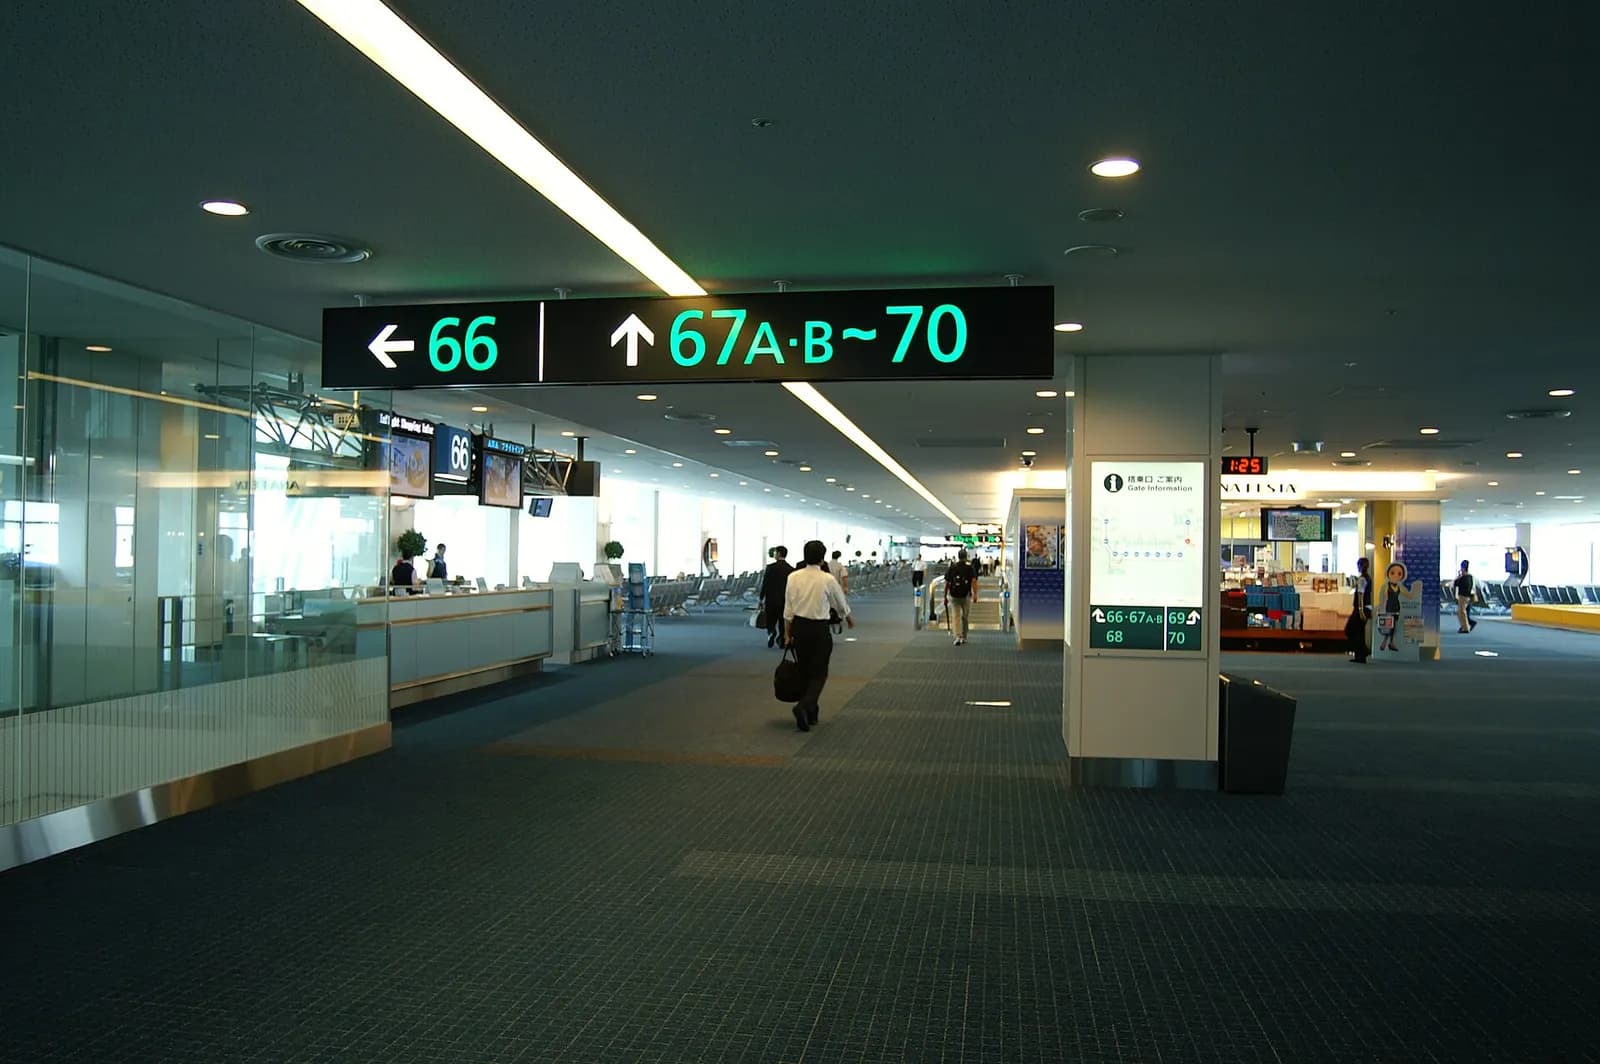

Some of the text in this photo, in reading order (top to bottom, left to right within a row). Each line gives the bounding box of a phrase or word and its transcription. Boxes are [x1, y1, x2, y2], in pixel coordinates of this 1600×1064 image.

[428, 315, 498, 372] 66
[451, 434, 469, 471] 66
[1127, 484, 1193, 492] Gate Information
[1168, 611, 1185, 624] 69
[1106, 630, 1123, 643] 68
[1168, 631, 1185, 644] 70
